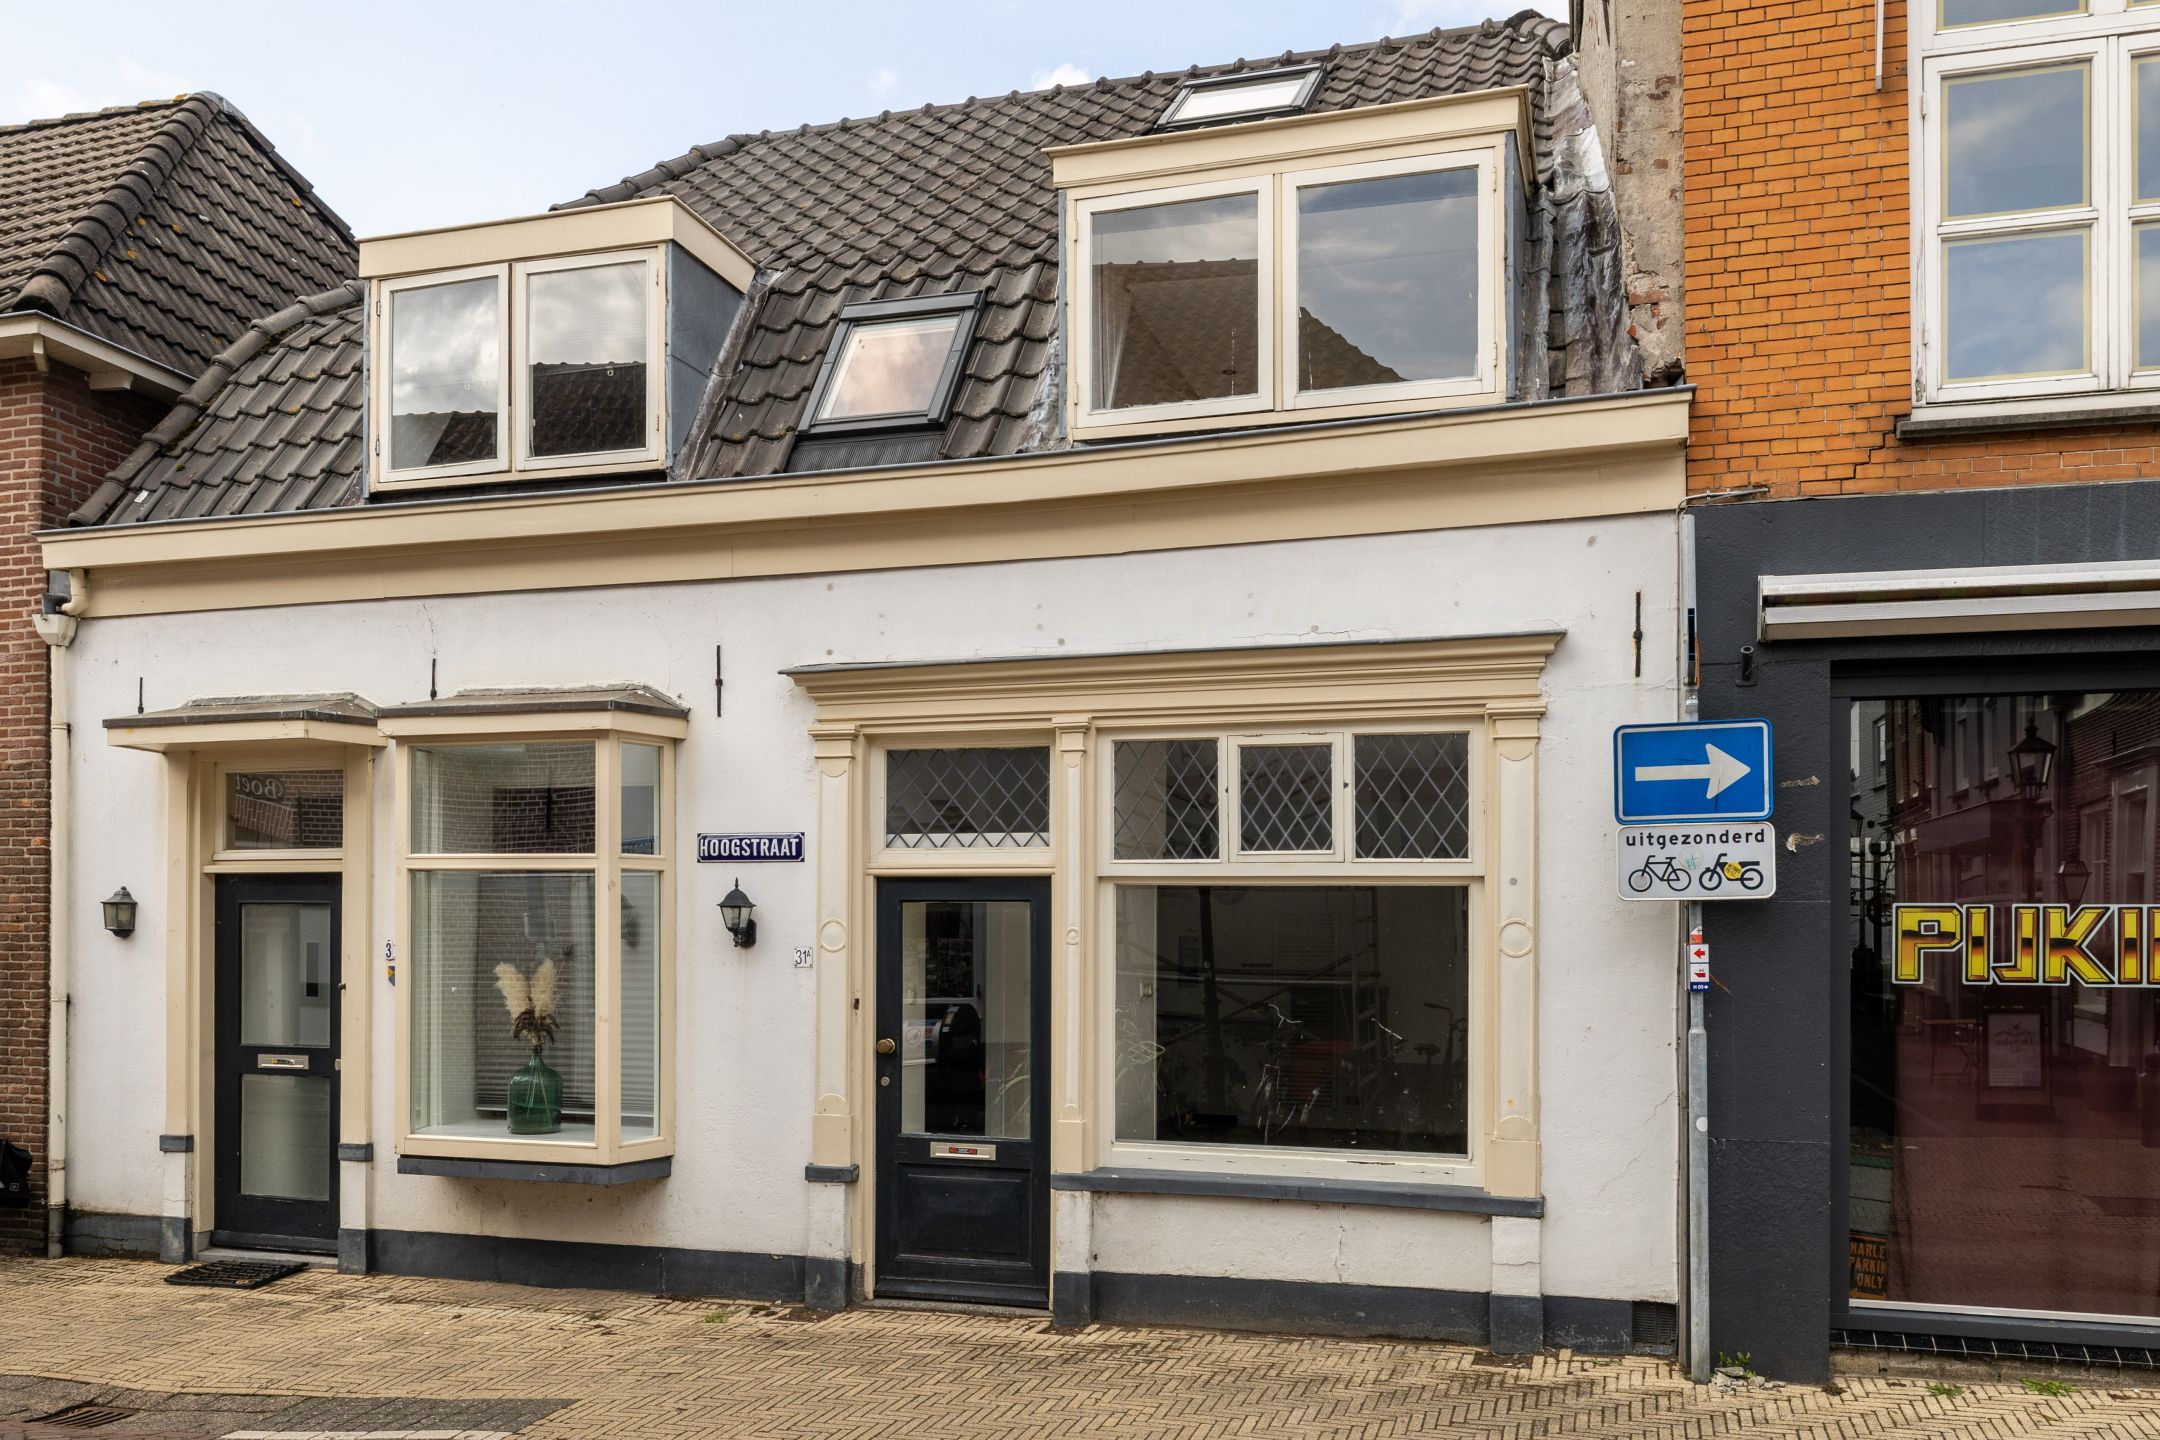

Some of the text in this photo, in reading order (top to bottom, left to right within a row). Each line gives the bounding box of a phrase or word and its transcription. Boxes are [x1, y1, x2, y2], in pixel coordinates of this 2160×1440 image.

[700, 838, 799, 857] HOOGSTRAAT
[1626, 828, 1765, 849] uitgezonderd
[1892, 903, 2160, 988] PIJKI
[1857, 1273, 1885, 1289] ONLY
